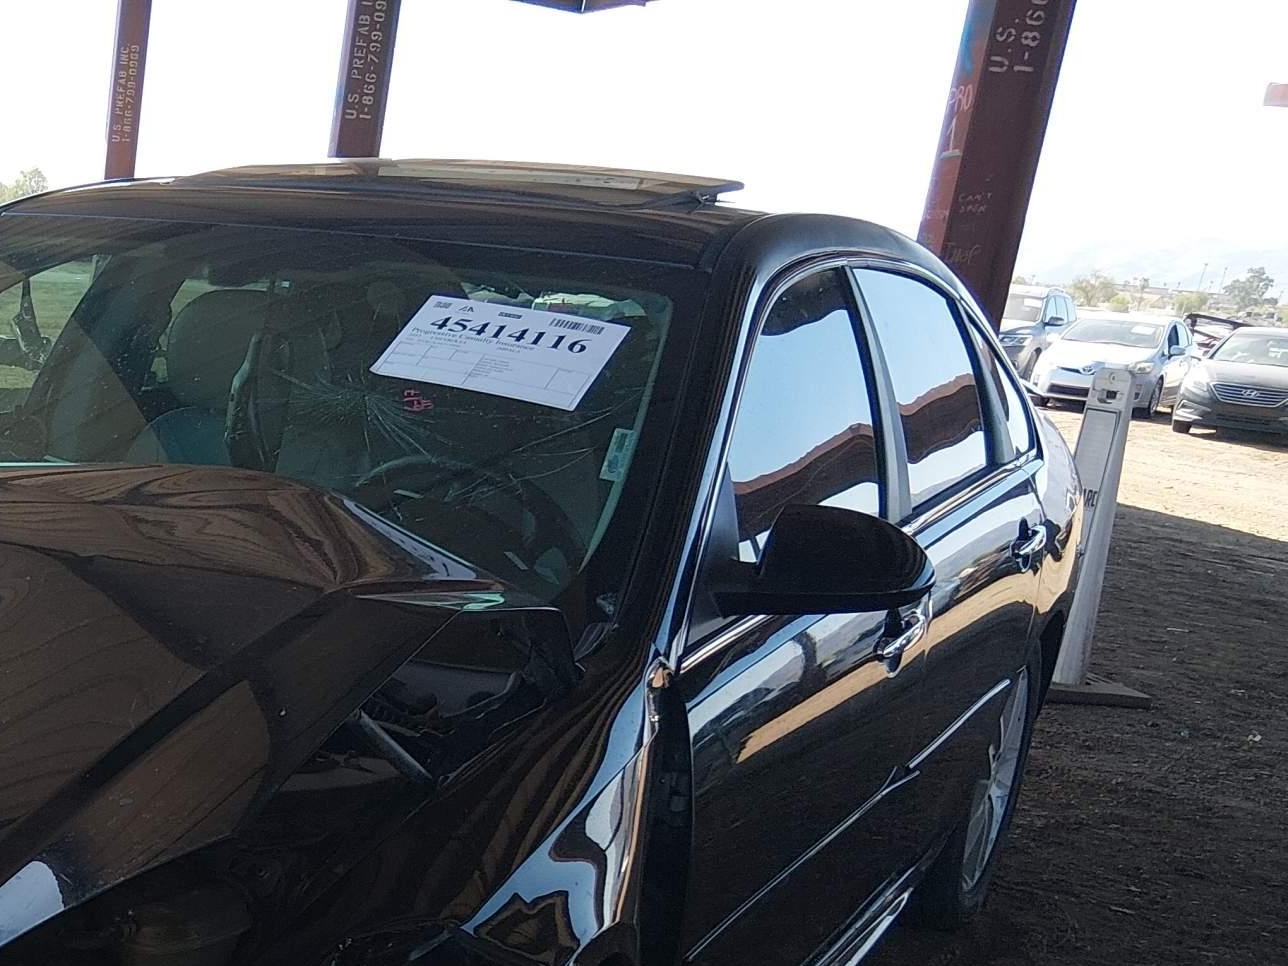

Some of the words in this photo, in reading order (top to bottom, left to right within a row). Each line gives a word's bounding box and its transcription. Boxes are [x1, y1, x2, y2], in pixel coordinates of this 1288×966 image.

[351, 15, 370, 79] PREFAB
[989, 18, 1019, 73] U.S.
[115, 71, 127, 114] PREFAB
[411, 327, 458, 339] Progressive
[459, 333, 493, 345] Casualty
[495, 340, 536, 351] Insurance
[430, 316, 592, 354] 45414116
